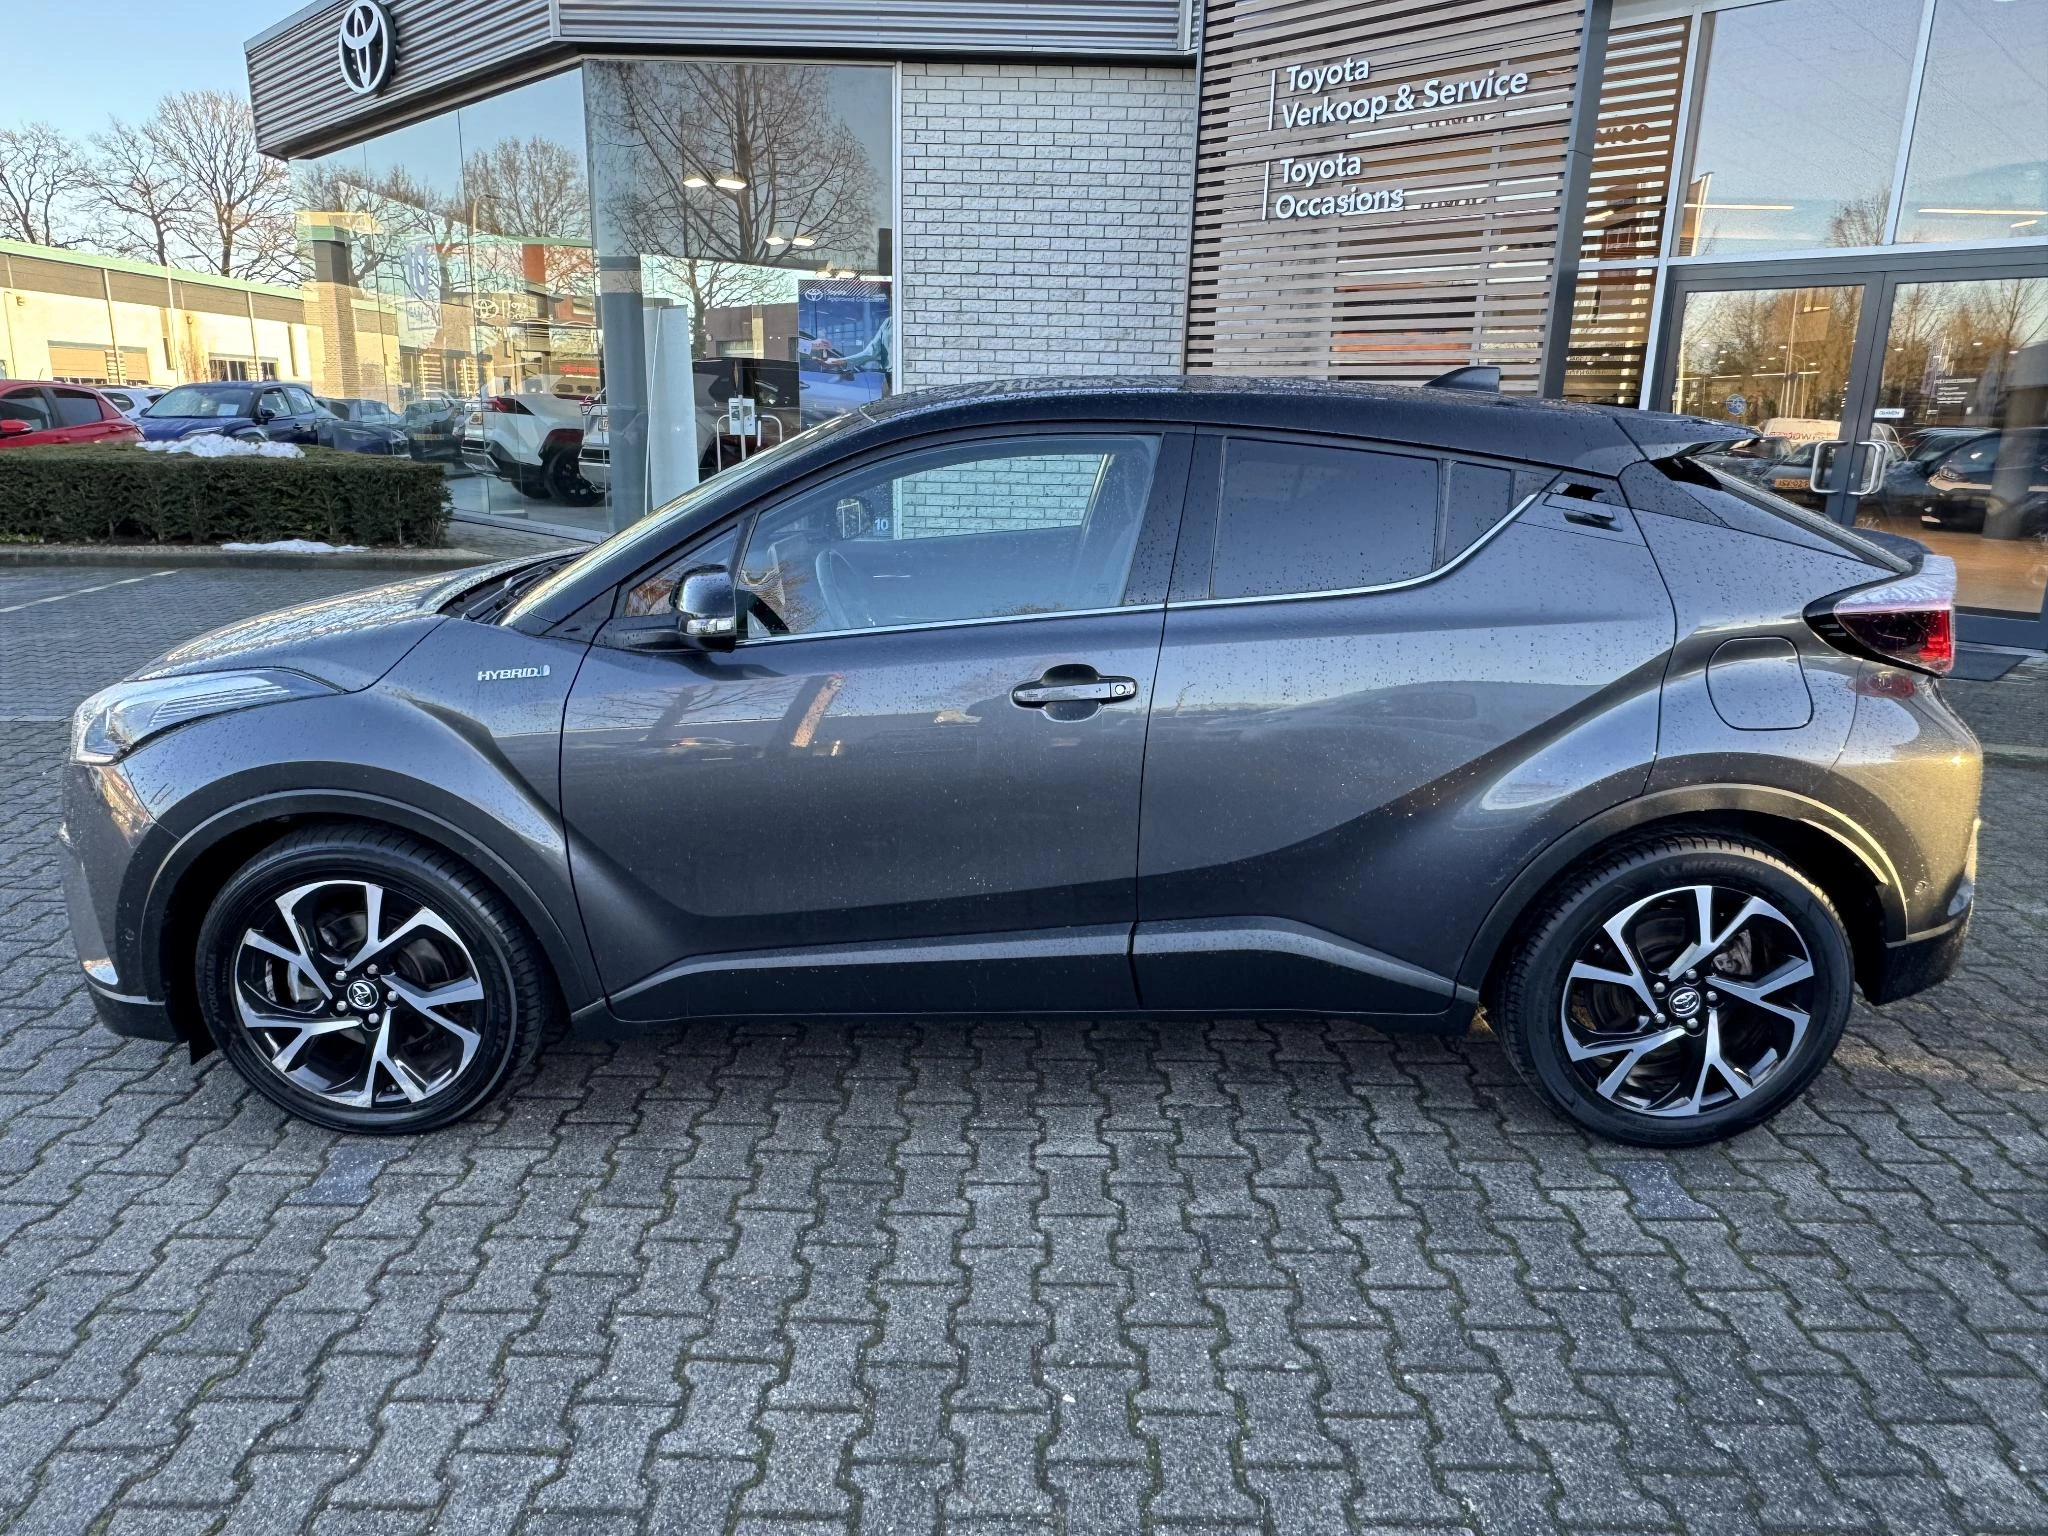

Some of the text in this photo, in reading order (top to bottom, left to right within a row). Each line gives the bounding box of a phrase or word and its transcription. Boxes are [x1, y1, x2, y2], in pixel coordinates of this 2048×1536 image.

[1286, 57, 1370, 94] Toyota
[1282, 69, 1529, 129] Verkoop & Service
[1280, 153, 1362, 187] Toyota
[1275, 187, 1405, 220] Occasions
[477, 667, 538, 681] HYBRID
